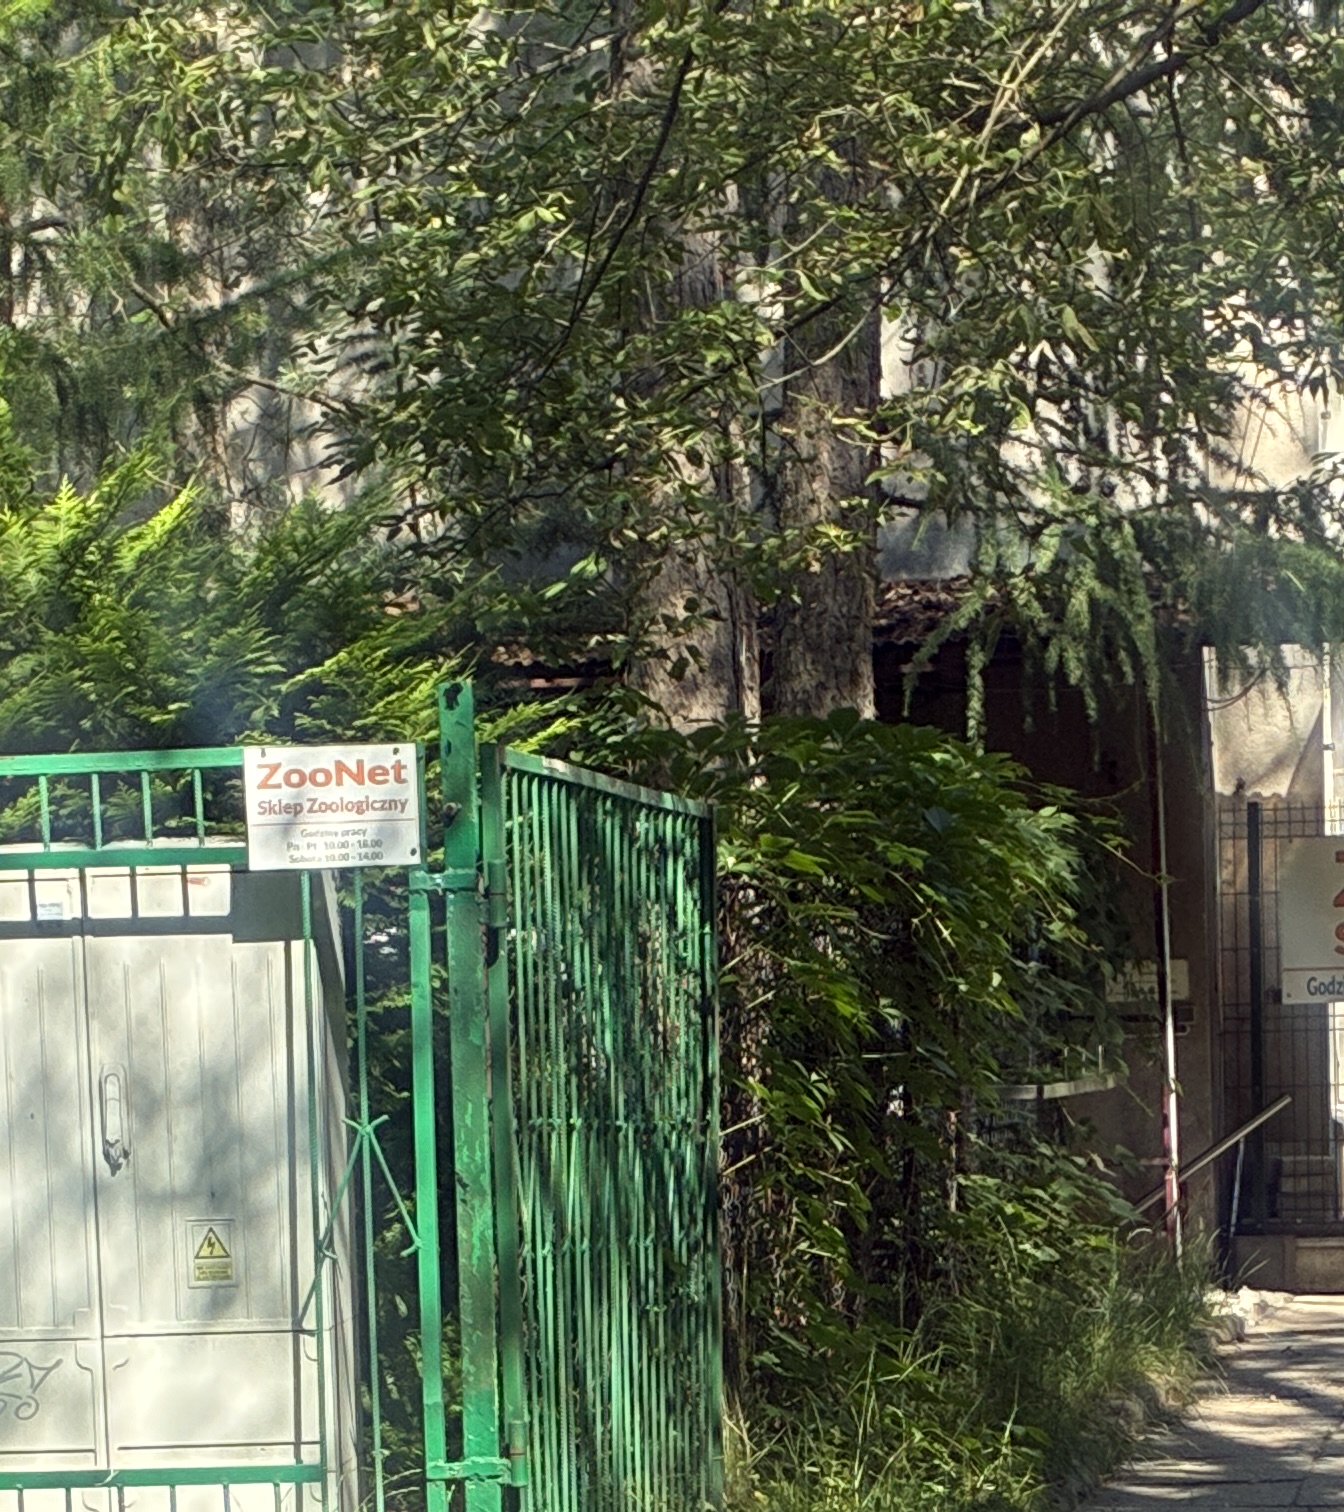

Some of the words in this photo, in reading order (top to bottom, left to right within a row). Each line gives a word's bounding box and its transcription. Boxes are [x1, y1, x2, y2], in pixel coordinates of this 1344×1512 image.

[256, 759, 409, 789] ZooNet
[257, 799, 304, 817] Sklep
[306, 795, 409, 815] Zoologiczny
[324, 840, 350, 851] 10.00
[325, 852, 350, 862] 10.00
